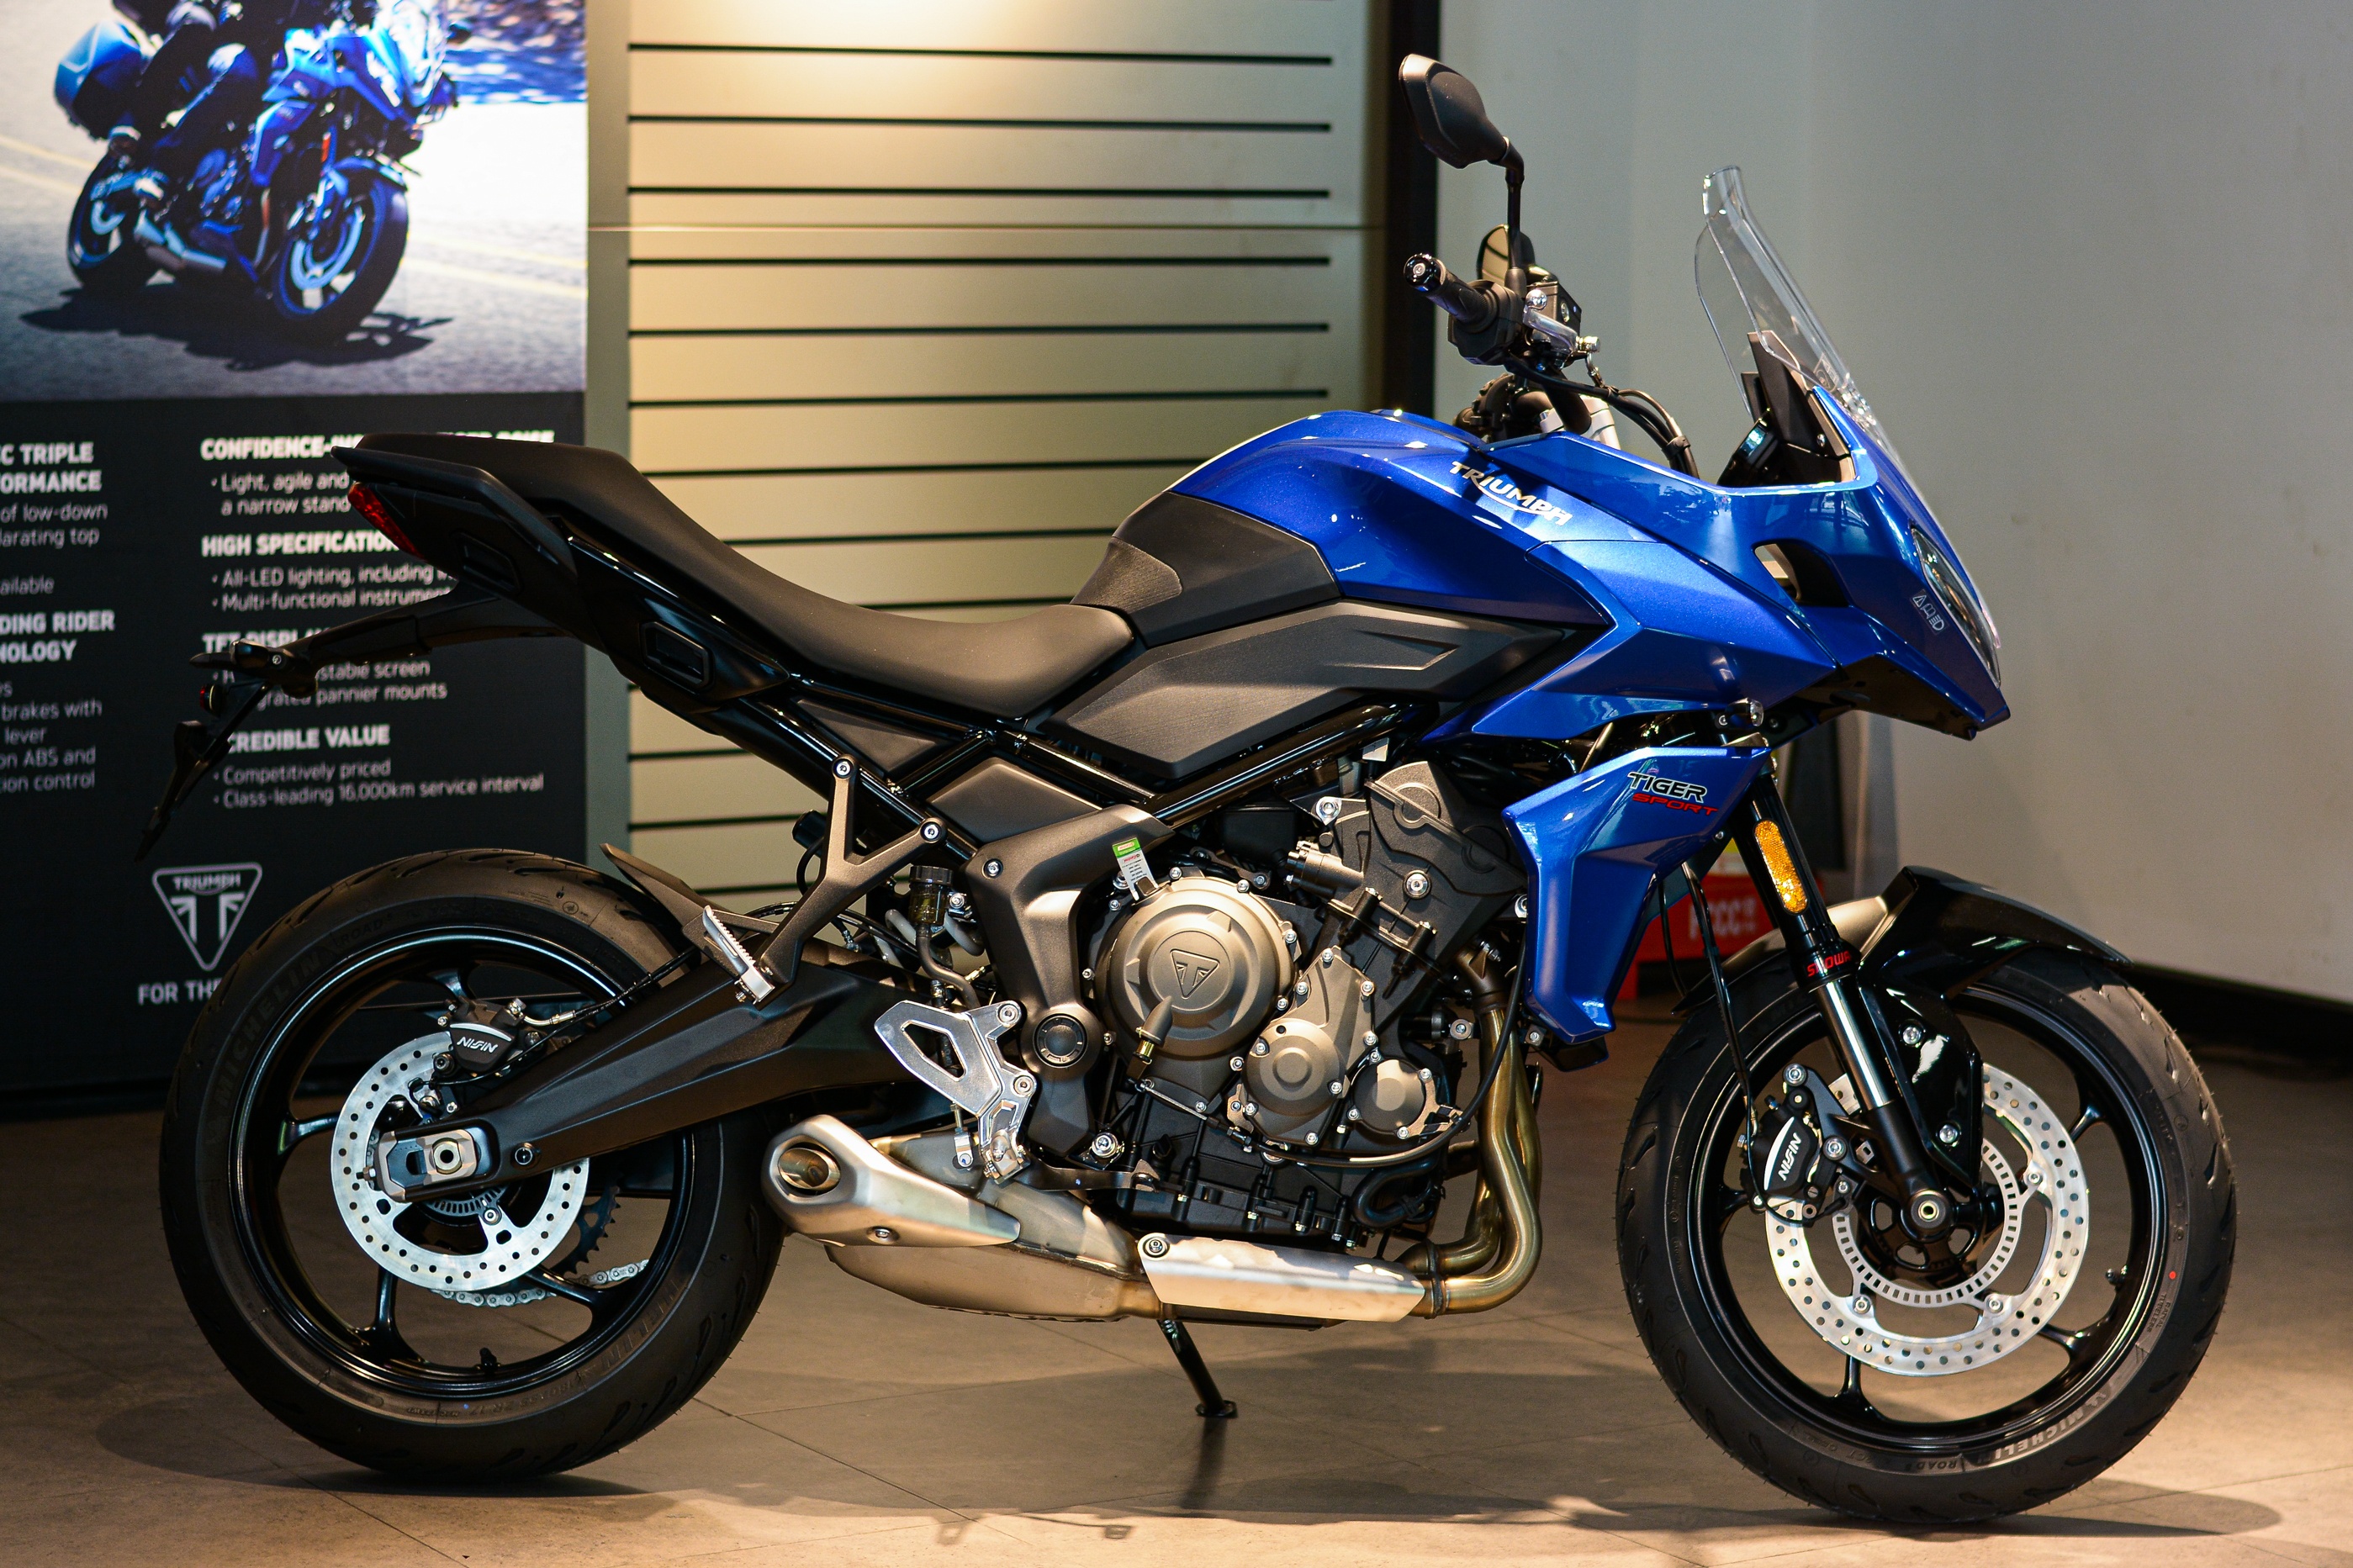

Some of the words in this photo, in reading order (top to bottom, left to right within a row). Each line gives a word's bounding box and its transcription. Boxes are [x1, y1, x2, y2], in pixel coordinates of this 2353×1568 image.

[0, 443, 15, 465] C
[19, 441, 94, 465] TRIPLE
[0, 469, 102, 494] ORMANCE
[220, 472, 270, 495] Light,
[272, 470, 314, 494] agile
[316, 469, 350, 489] and
[1449, 461, 1573, 526] TRIUMPH
[0, 502, 19, 523] of
[23, 502, 108, 521] low-down
[220, 499, 233, 516] a
[236, 499, 299, 515] narrow
[70, 528, 100, 546] top
[201, 534, 251, 557] HIGH
[222, 567, 284, 588] All-LED
[288, 564, 355, 589] lighting,
[359, 563, 434, 585] including
[222, 588, 356, 612] Multi-functional
[0, 612, 47, 635] DING
[52, 609, 115, 632] RIDER
[374, 660, 431, 678] screen
[315, 685, 380, 708] pannier
[384, 682, 448, 700] mounts
[2, 701, 60, 721] brakes
[64, 697, 103, 718] with
[4, 726, 47, 746] lever
[325, 723, 390, 747] VALUE
[23, 747, 58, 768] ABS
[63, 745, 96, 765] and
[0, 775, 29, 795] ion
[33, 768, 95, 792] control
[223, 759, 336, 786] Competitively
[340, 758, 391, 780] priced
[223, 786, 335, 808] Class-leading
[339, 782, 415, 803] 16,000km
[420, 778, 478, 798] service
[482, 772, 544, 794] interval
[1627, 772, 1707, 804] TIGER
[1632, 793, 1719, 816] SPORT
[172, 871, 241, 892] TRIUMPH
[138, 981, 178, 1006] FOR
[1976, 1407, 2085, 1464] MICHELIN
